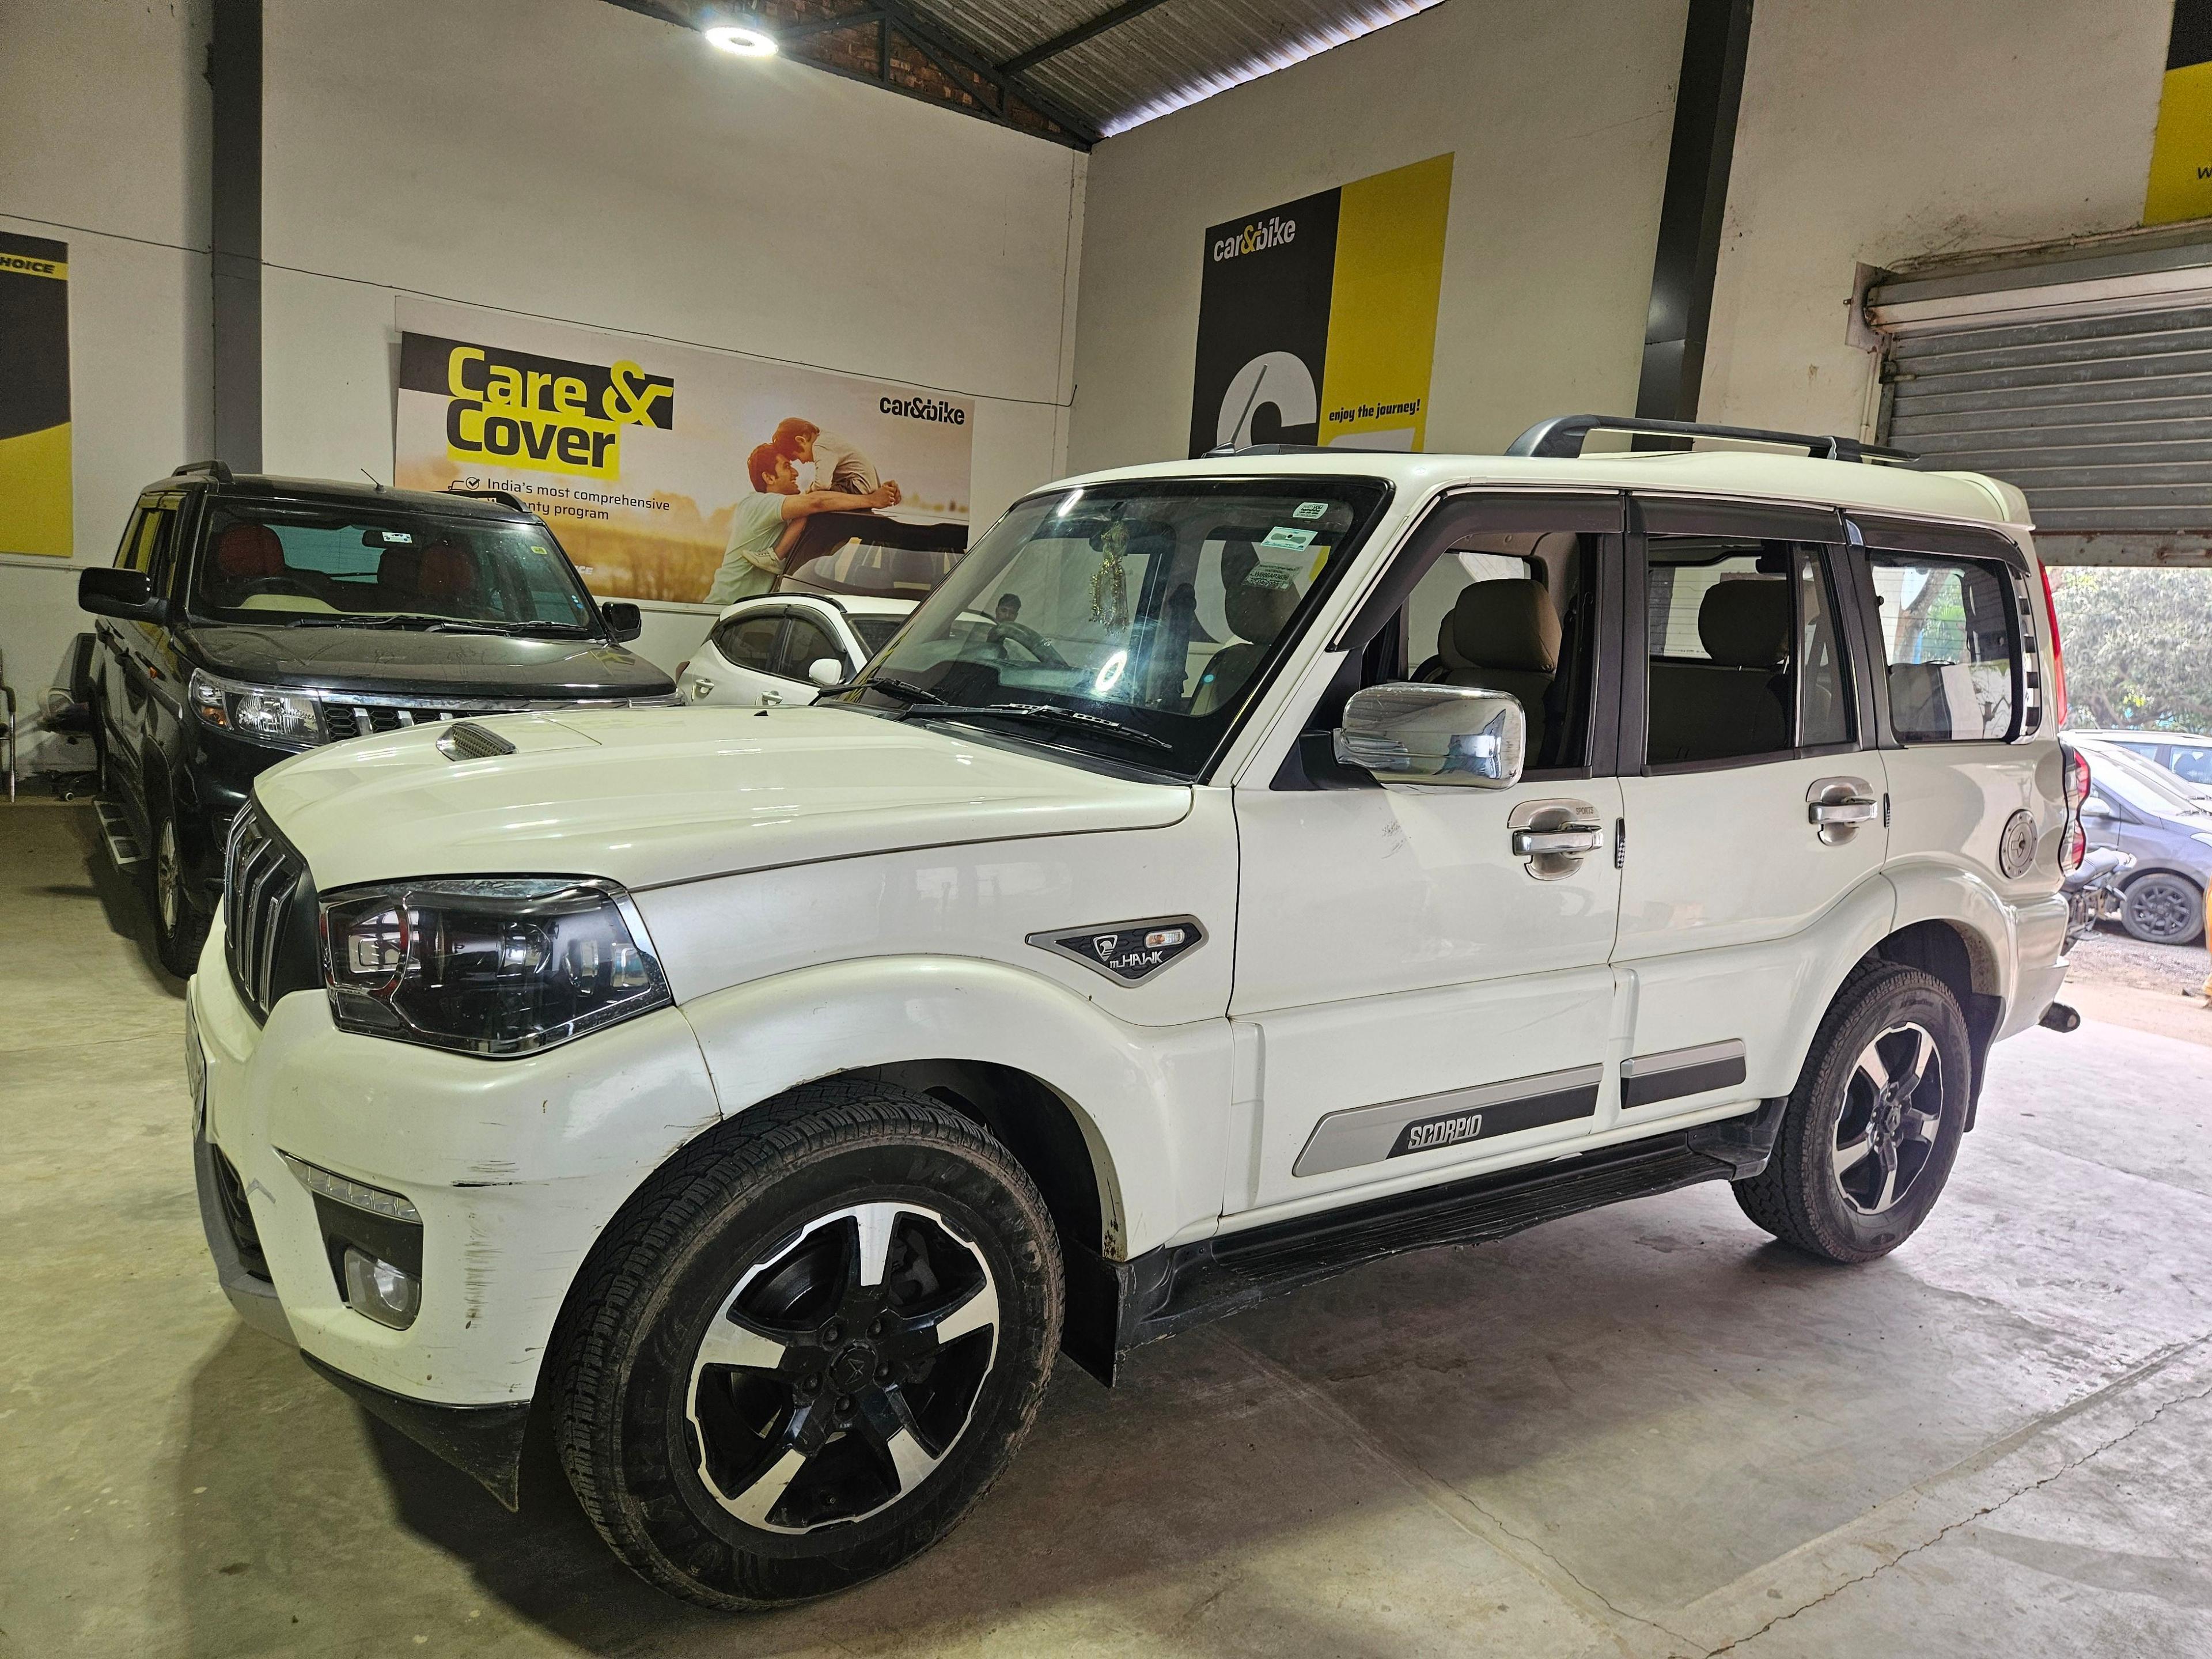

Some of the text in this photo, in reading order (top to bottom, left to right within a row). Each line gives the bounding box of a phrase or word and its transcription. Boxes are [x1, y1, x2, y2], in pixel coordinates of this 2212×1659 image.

[1214, 217, 1296, 262] car&bike
[448, 347, 674, 428] Care &
[880, 397, 965, 425] car&bike
[1329, 399, 1421, 423] enjoy the journey!
[447, 399, 616, 468] Cover
[488, 478, 670, 511] India’s most comprehensive
[554, 504, 609, 520] program
[1575, 806, 1594, 815] SPORTS
[1408, 1114, 1483, 1150] SCORPIO
